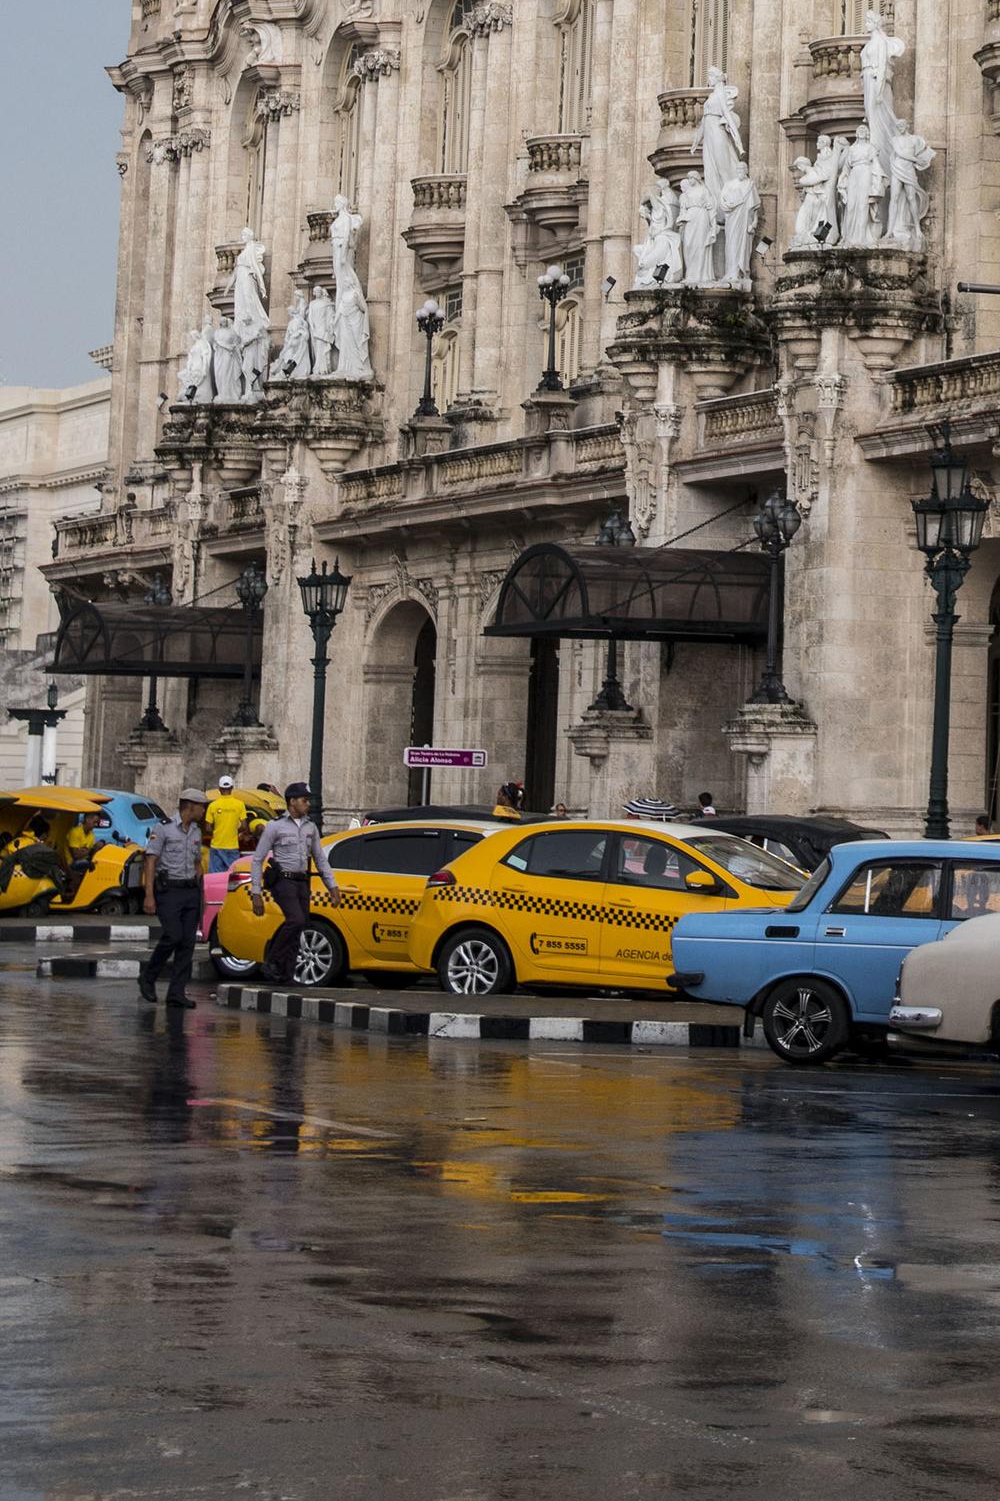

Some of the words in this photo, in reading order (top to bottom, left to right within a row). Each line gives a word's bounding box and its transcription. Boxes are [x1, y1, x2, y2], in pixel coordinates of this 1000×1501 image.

[409, 755, 429, 763] Alicia
[430, 756, 453, 764] Alonso
[546, 940, 562, 949] 855
[564, 941, 586, 951] 5555
[615, 948, 660, 960] AGENCIA
[661, 952, 673, 962] de
